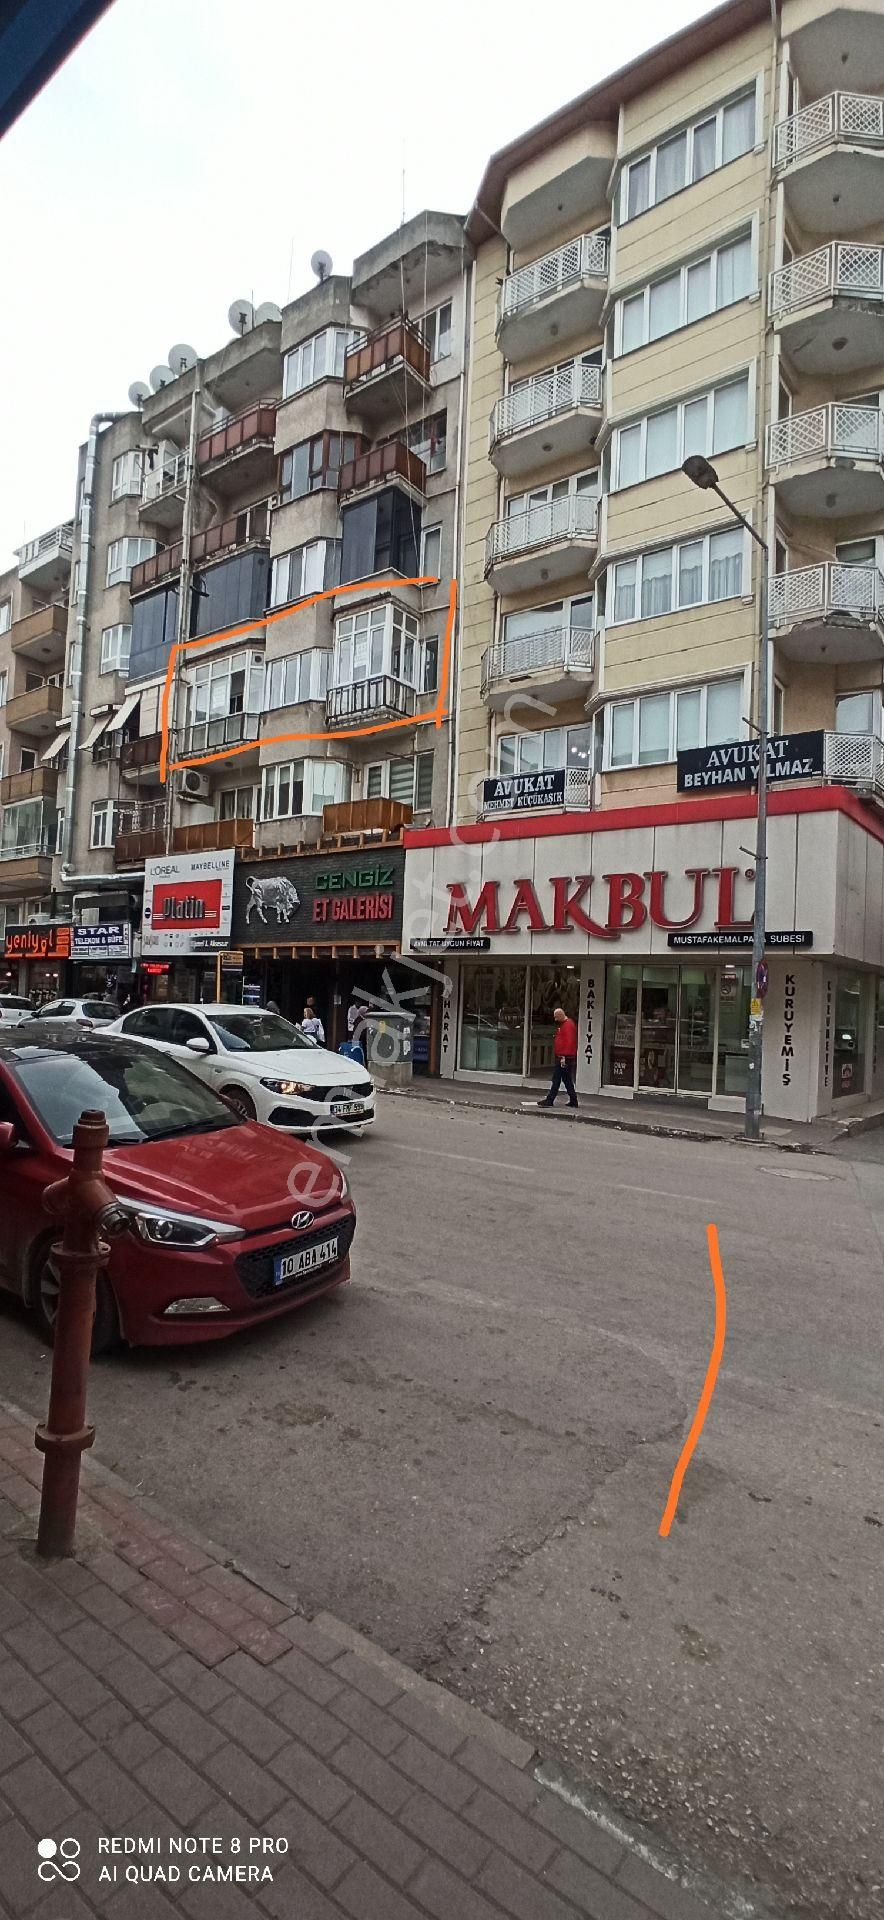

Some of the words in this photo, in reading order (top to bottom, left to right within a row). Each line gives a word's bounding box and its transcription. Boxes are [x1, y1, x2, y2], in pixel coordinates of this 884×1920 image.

[706, 739, 789, 768] AVUKAT
[493, 774, 555, 797] AVUKAT
[684, 767, 746, 788] BEYHAN
[750, 758, 814, 779] YLMAZ
[190, 859, 230, 872] MAYBELLINE
[162, 896, 206, 921] Platin
[313, 899, 329, 922] ET
[442, 866, 756, 940] MAKBUL
[77, 926, 120, 936] STAR
[585, 979, 595, 1065] BAKLİYAT
[781, 974, 796, 1086] KURUYEMİŞ
[282, 1258, 294, 1276] 10
[299, 1249, 317, 1270] ABA
[320, 1240, 336, 1260] 414
